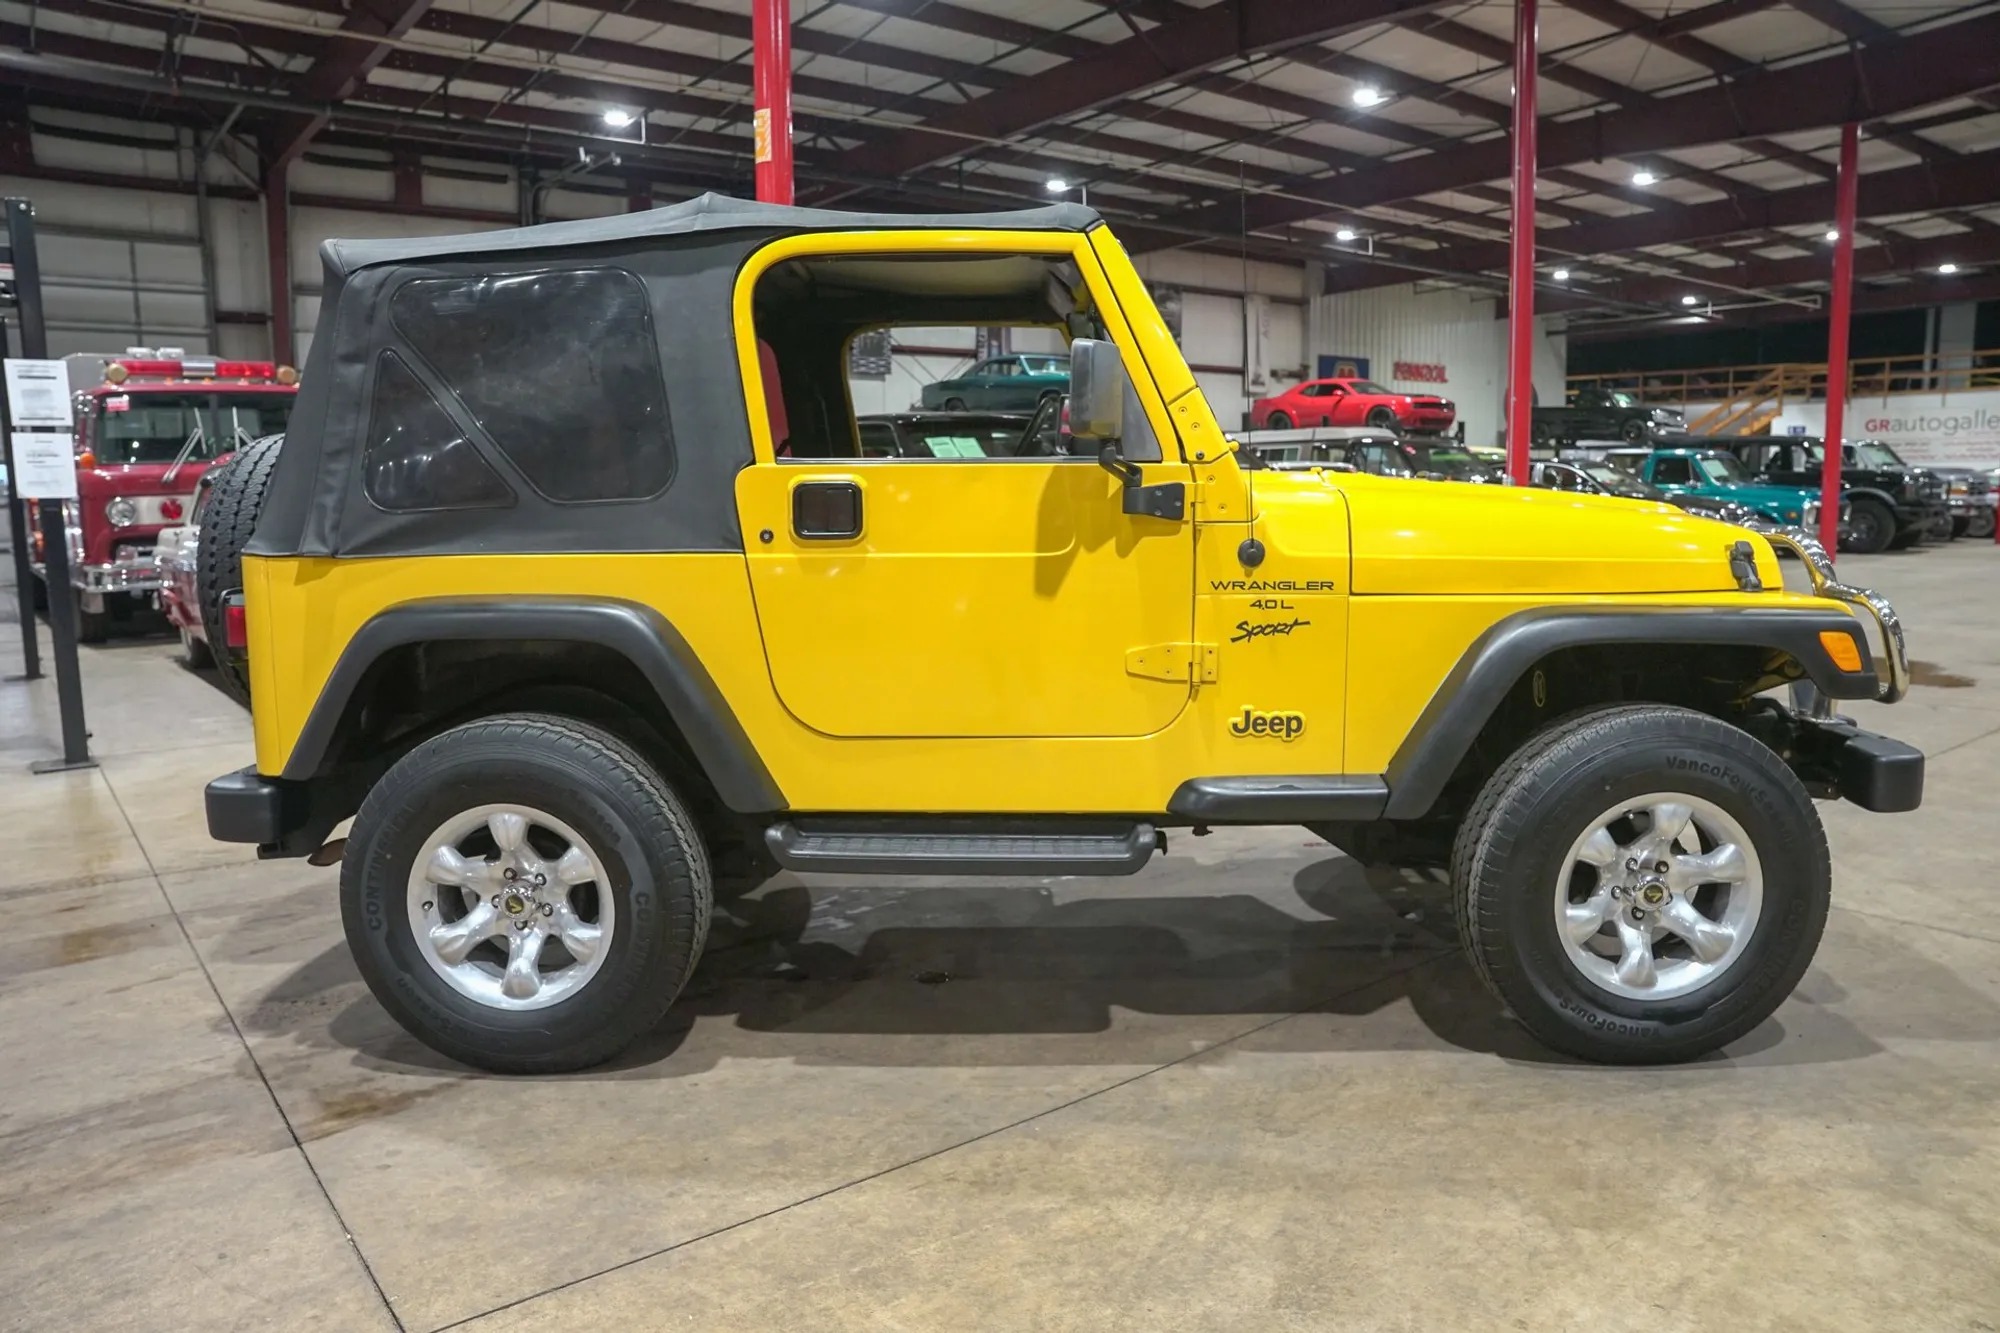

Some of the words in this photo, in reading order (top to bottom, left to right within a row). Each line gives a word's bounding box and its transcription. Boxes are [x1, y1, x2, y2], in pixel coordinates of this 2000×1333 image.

[1211, 581, 1334, 591] WRANGLER
[1230, 618, 1311, 643] Sport
[1231, 710, 1304, 738] Jeep
